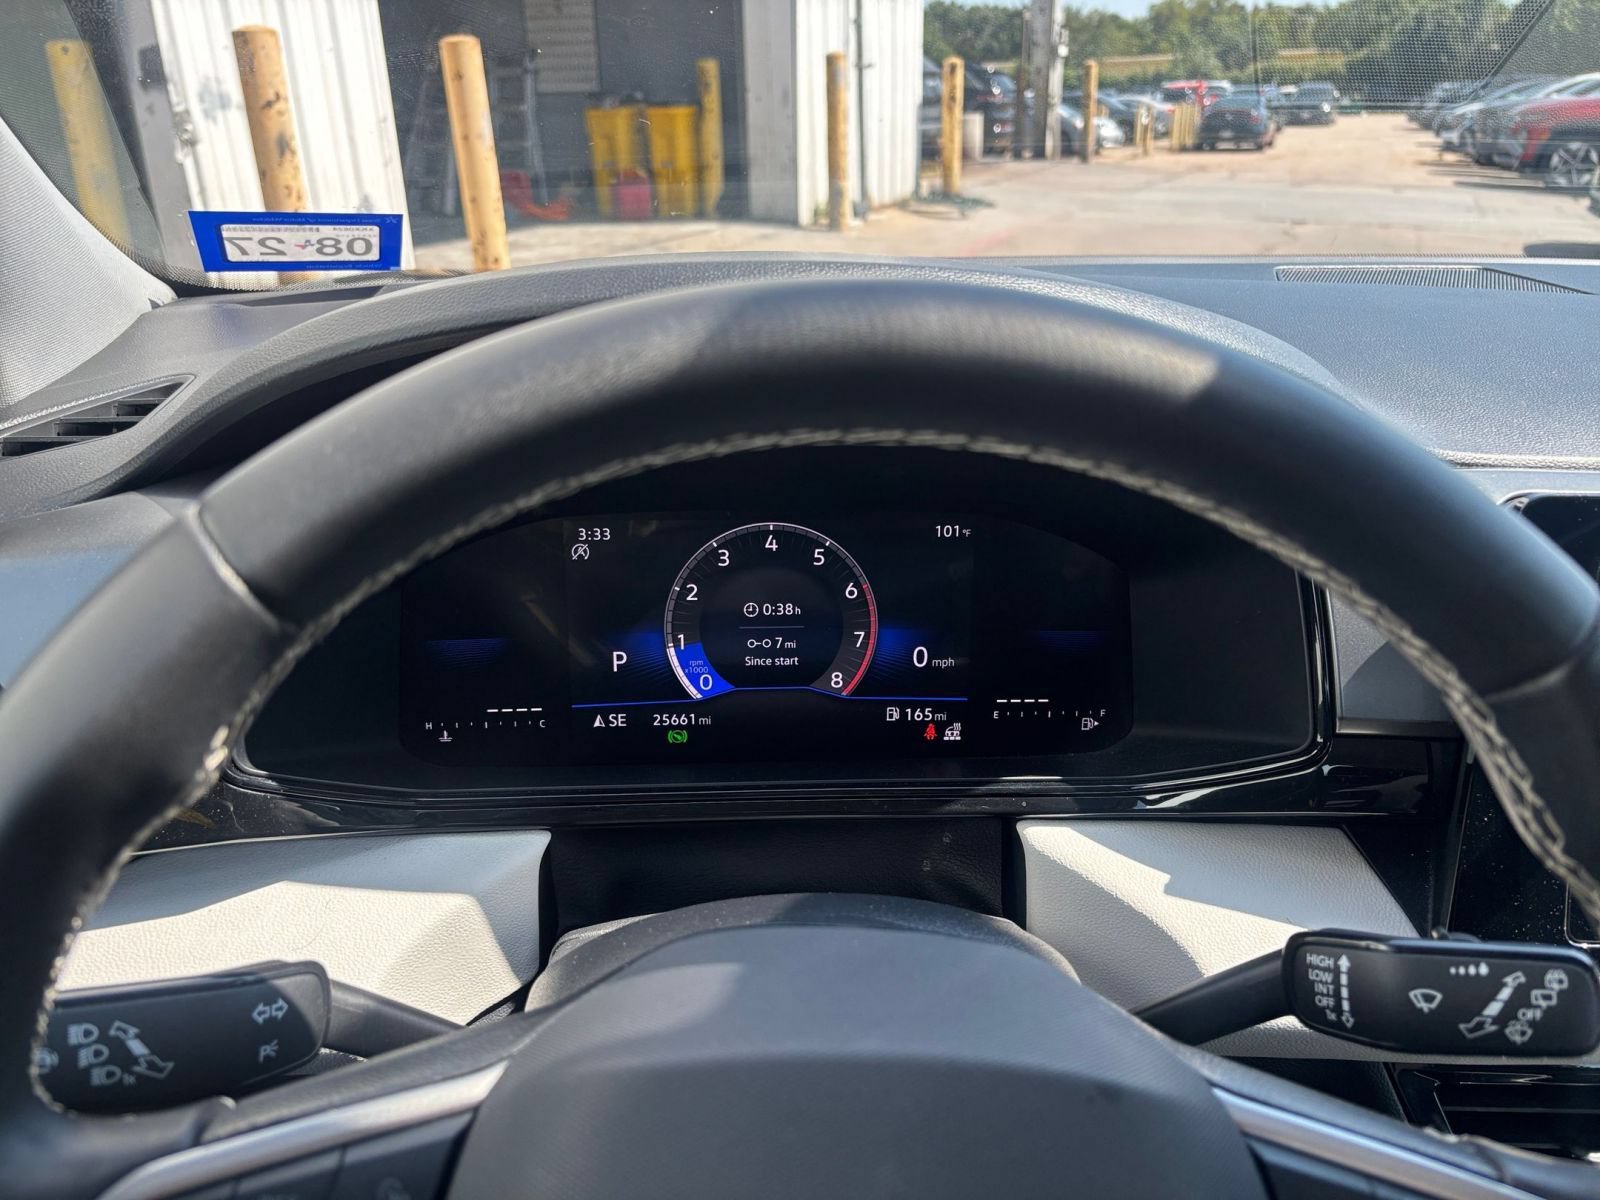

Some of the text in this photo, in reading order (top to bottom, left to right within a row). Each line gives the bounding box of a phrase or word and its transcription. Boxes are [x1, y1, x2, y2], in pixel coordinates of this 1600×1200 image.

[578, 527, 611, 541] 3:33
[764, 534, 779, 552] 4
[718, 549, 730, 567] 3
[813, 548, 825, 566] 5
[686, 583, 698, 601] 2
[845, 582, 858, 599] 6
[676, 634, 686, 651] 1
[775, 637, 796, 649] 7 mi
[853, 631, 865, 648] 7
[612, 651, 628, 672] P
[689, 660, 705, 669] rpm
[745, 656, 799, 666] Since start
[913, 646, 955, 669] 0 mph
[684, 666, 710, 675] x1000
[699, 674, 713, 691] 0
[830, 671, 845, 688] 8
[608, 713, 627, 727] SE
[653, 713, 712, 726] 25661 mi
[905, 707, 947, 721] 165 mi
[993, 710, 999, 719] E
[1100, 709, 1106, 717] F
[425, 721, 433, 730] H
[539, 719, 546, 728] C
[1306, 953, 1335, 970] HIGH
[1308, 968, 1334, 984] LOW
[1314, 982, 1335, 996] INT
[1314, 996, 1335, 1009] OFF
[1517, 1007, 1544, 1022] OFF
